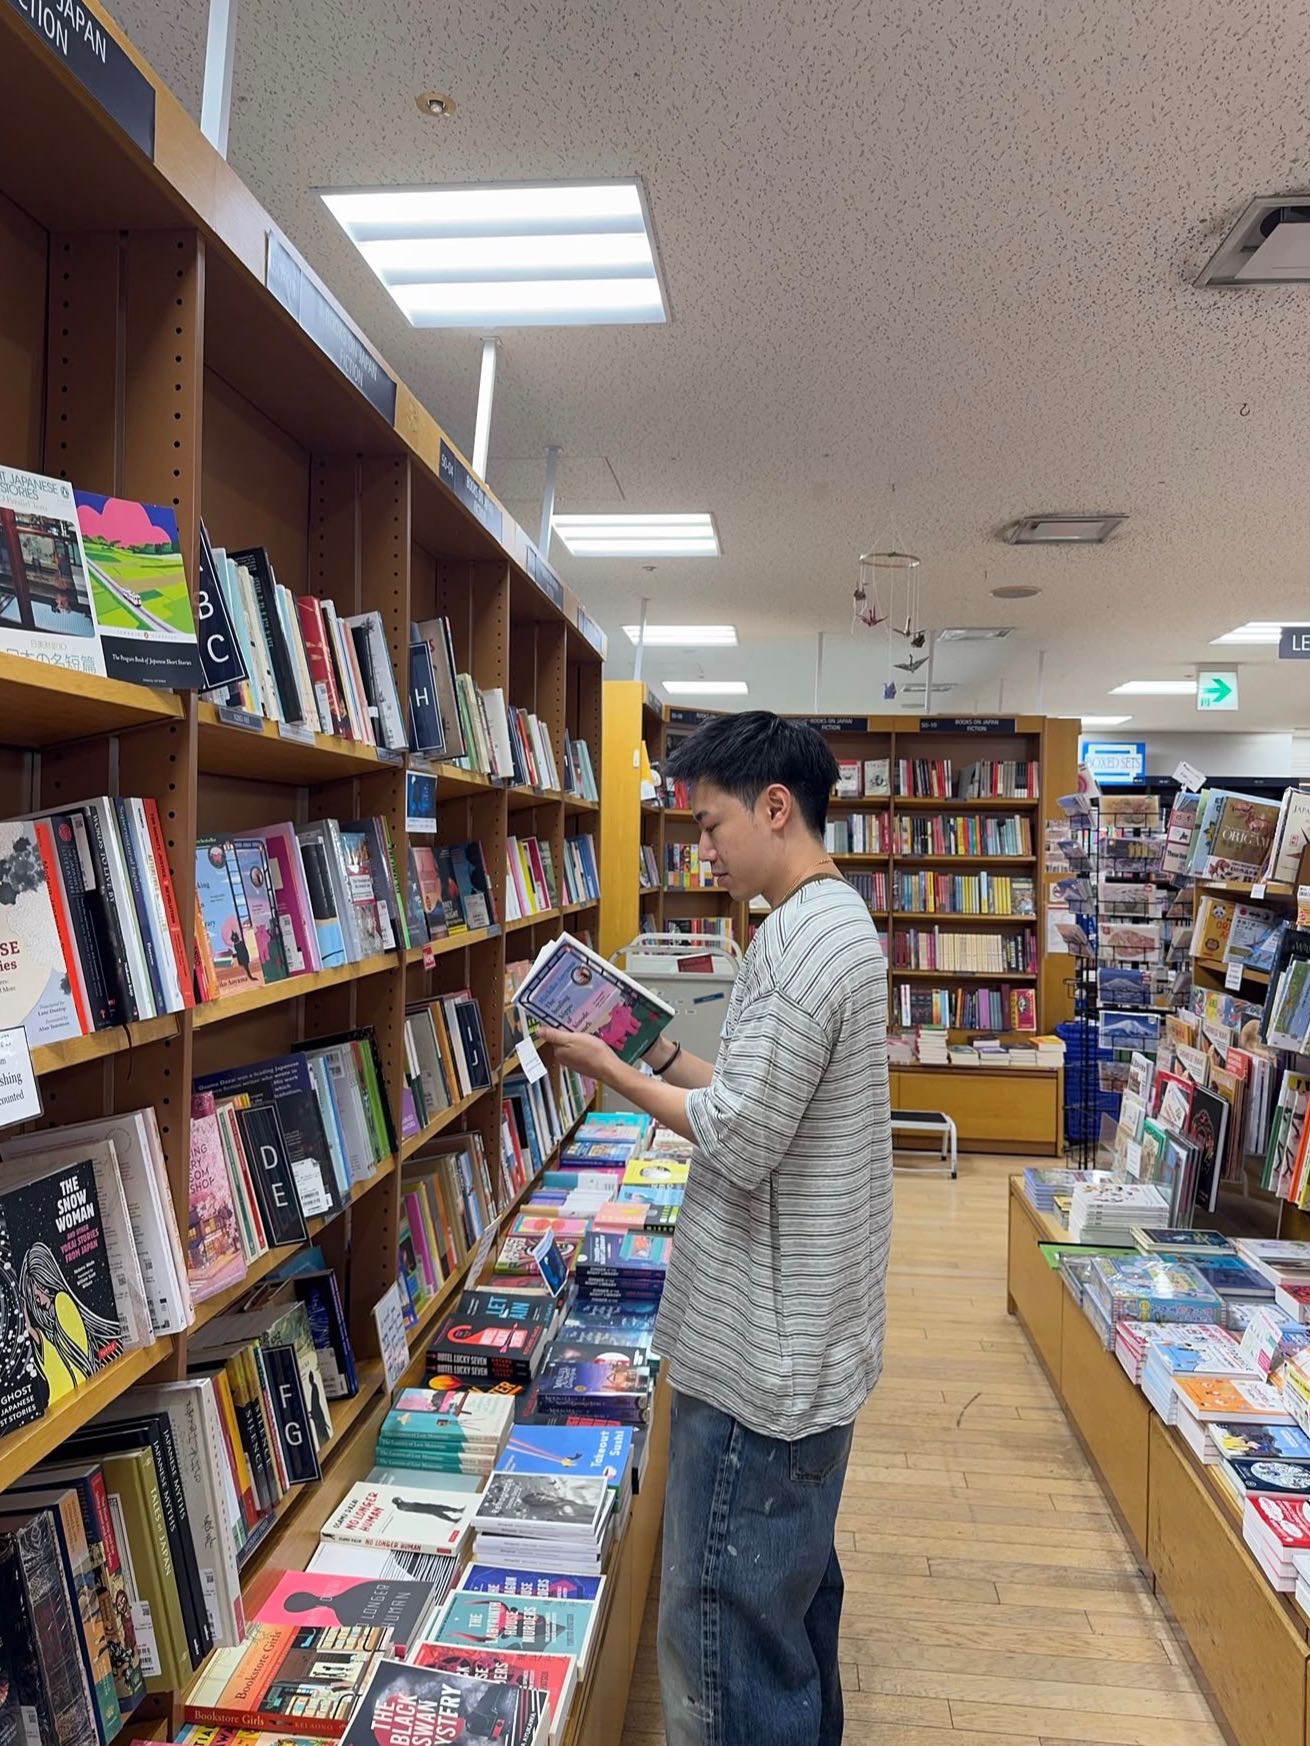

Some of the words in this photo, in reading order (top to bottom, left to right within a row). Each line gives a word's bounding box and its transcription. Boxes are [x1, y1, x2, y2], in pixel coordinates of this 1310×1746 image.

[1, 483, 40, 501] STORIES
[11, 473, 59, 495] JAPANESE
[199, 591, 214, 620] B
[207, 634, 229, 663] C
[1293, 634, 1310, 651] LE
[414, 687, 429, 707] H
[91, 813, 104, 849] WORDS
[102, 865, 114, 889] LIVE
[0, 940, 20, 957] SE
[0, 1072, 23, 1087] shing
[260, 1145, 278, 1170] D
[60, 1176, 79, 1196] THE
[272, 1182, 288, 1207] E
[57, 1189, 87, 1215] SNOW
[55, 1202, 95, 1233] WOMAN
[77, 1228, 99, 1246] STORIES
[81, 1240, 98, 1255] JAPAN
[454, 1354, 470, 1364] LUCKY
[471, 1356, 487, 1366] SEVEN
[454, 1365, 470, 1375] LUCKY
[471, 1367, 488, 1376] SEVEN
[0, 1384, 32, 1406] GHOST
[1, 1395, 35, 1416] JAPANESE
[279, 1384, 291, 1409] F
[8, 1404, 37, 1422] STORIES
[246, 1409, 263, 1474] SILENCE
[254, 1403, 271, 1466] SILENCE
[285, 1422, 303, 1446] G
[610, 1430, 624, 1456] Sushi
[591, 1430, 610, 1467] Takeout
[153, 1440, 169, 1490] JAPANESE
[163, 1492, 176, 1534] MYTHS
[164, 1429, 180, 1479] JAPANESE
[174, 1481, 186, 1521] MYTHS
[345, 1518, 359, 1530] NO
[358, 1491, 378, 1520] LONGER
[360, 1507, 384, 1532] HUMAN
[150, 1487, 162, 1522] TALES
[160, 1535, 173, 1577] JAPAN
[365, 1538, 373, 1546] NO
[375, 1540, 398, 1548] LONGER
[400, 1542, 421, 1550] HUMAN
[360, 1584, 390, 1619] LONGER
[469, 1613, 482, 1628] THE
[504, 1610, 518, 1636] HOUSE
[522, 1606, 536, 1643] MURDERS
[236, 1653, 269, 1700] Bookstore
[264, 1630, 282, 1653] Girls
[194, 1710, 239, 1725] Bookstore
[242, 1714, 265, 1727] Girls
[371, 1699, 395, 1731] THE
[390, 1693, 417, 1746] BLACK
[412, 1699, 438, 1746] SWAN
[434, 1683, 461, 1745] YSTERY
[524, 1712, 537, 1740] AYUKAWA
